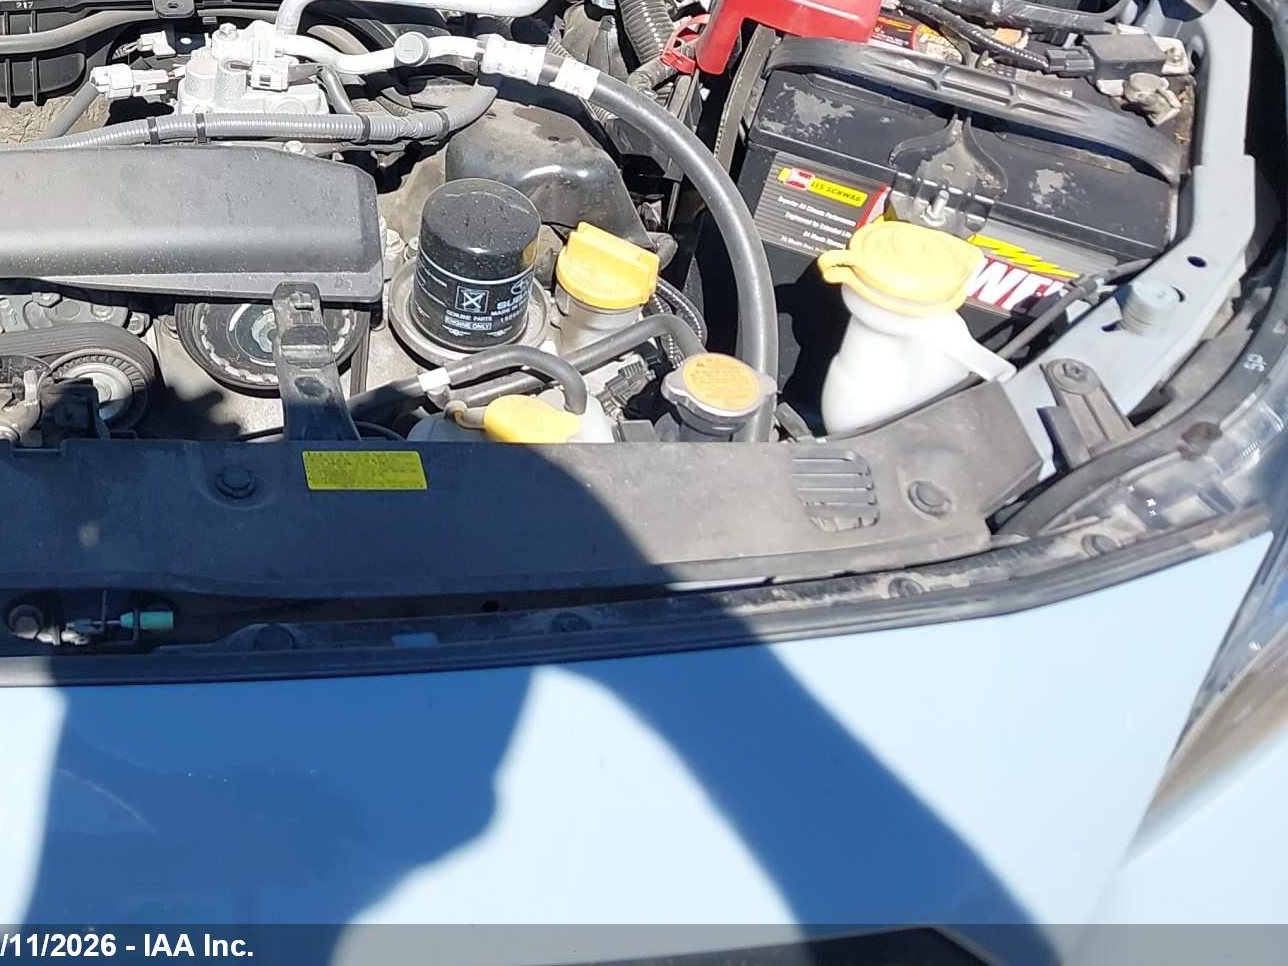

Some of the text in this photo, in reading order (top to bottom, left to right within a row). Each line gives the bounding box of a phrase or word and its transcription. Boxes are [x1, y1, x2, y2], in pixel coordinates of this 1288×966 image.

[446, 309, 472, 321] GENUINE
[446, 317, 490, 330] ENGINE ONLY
